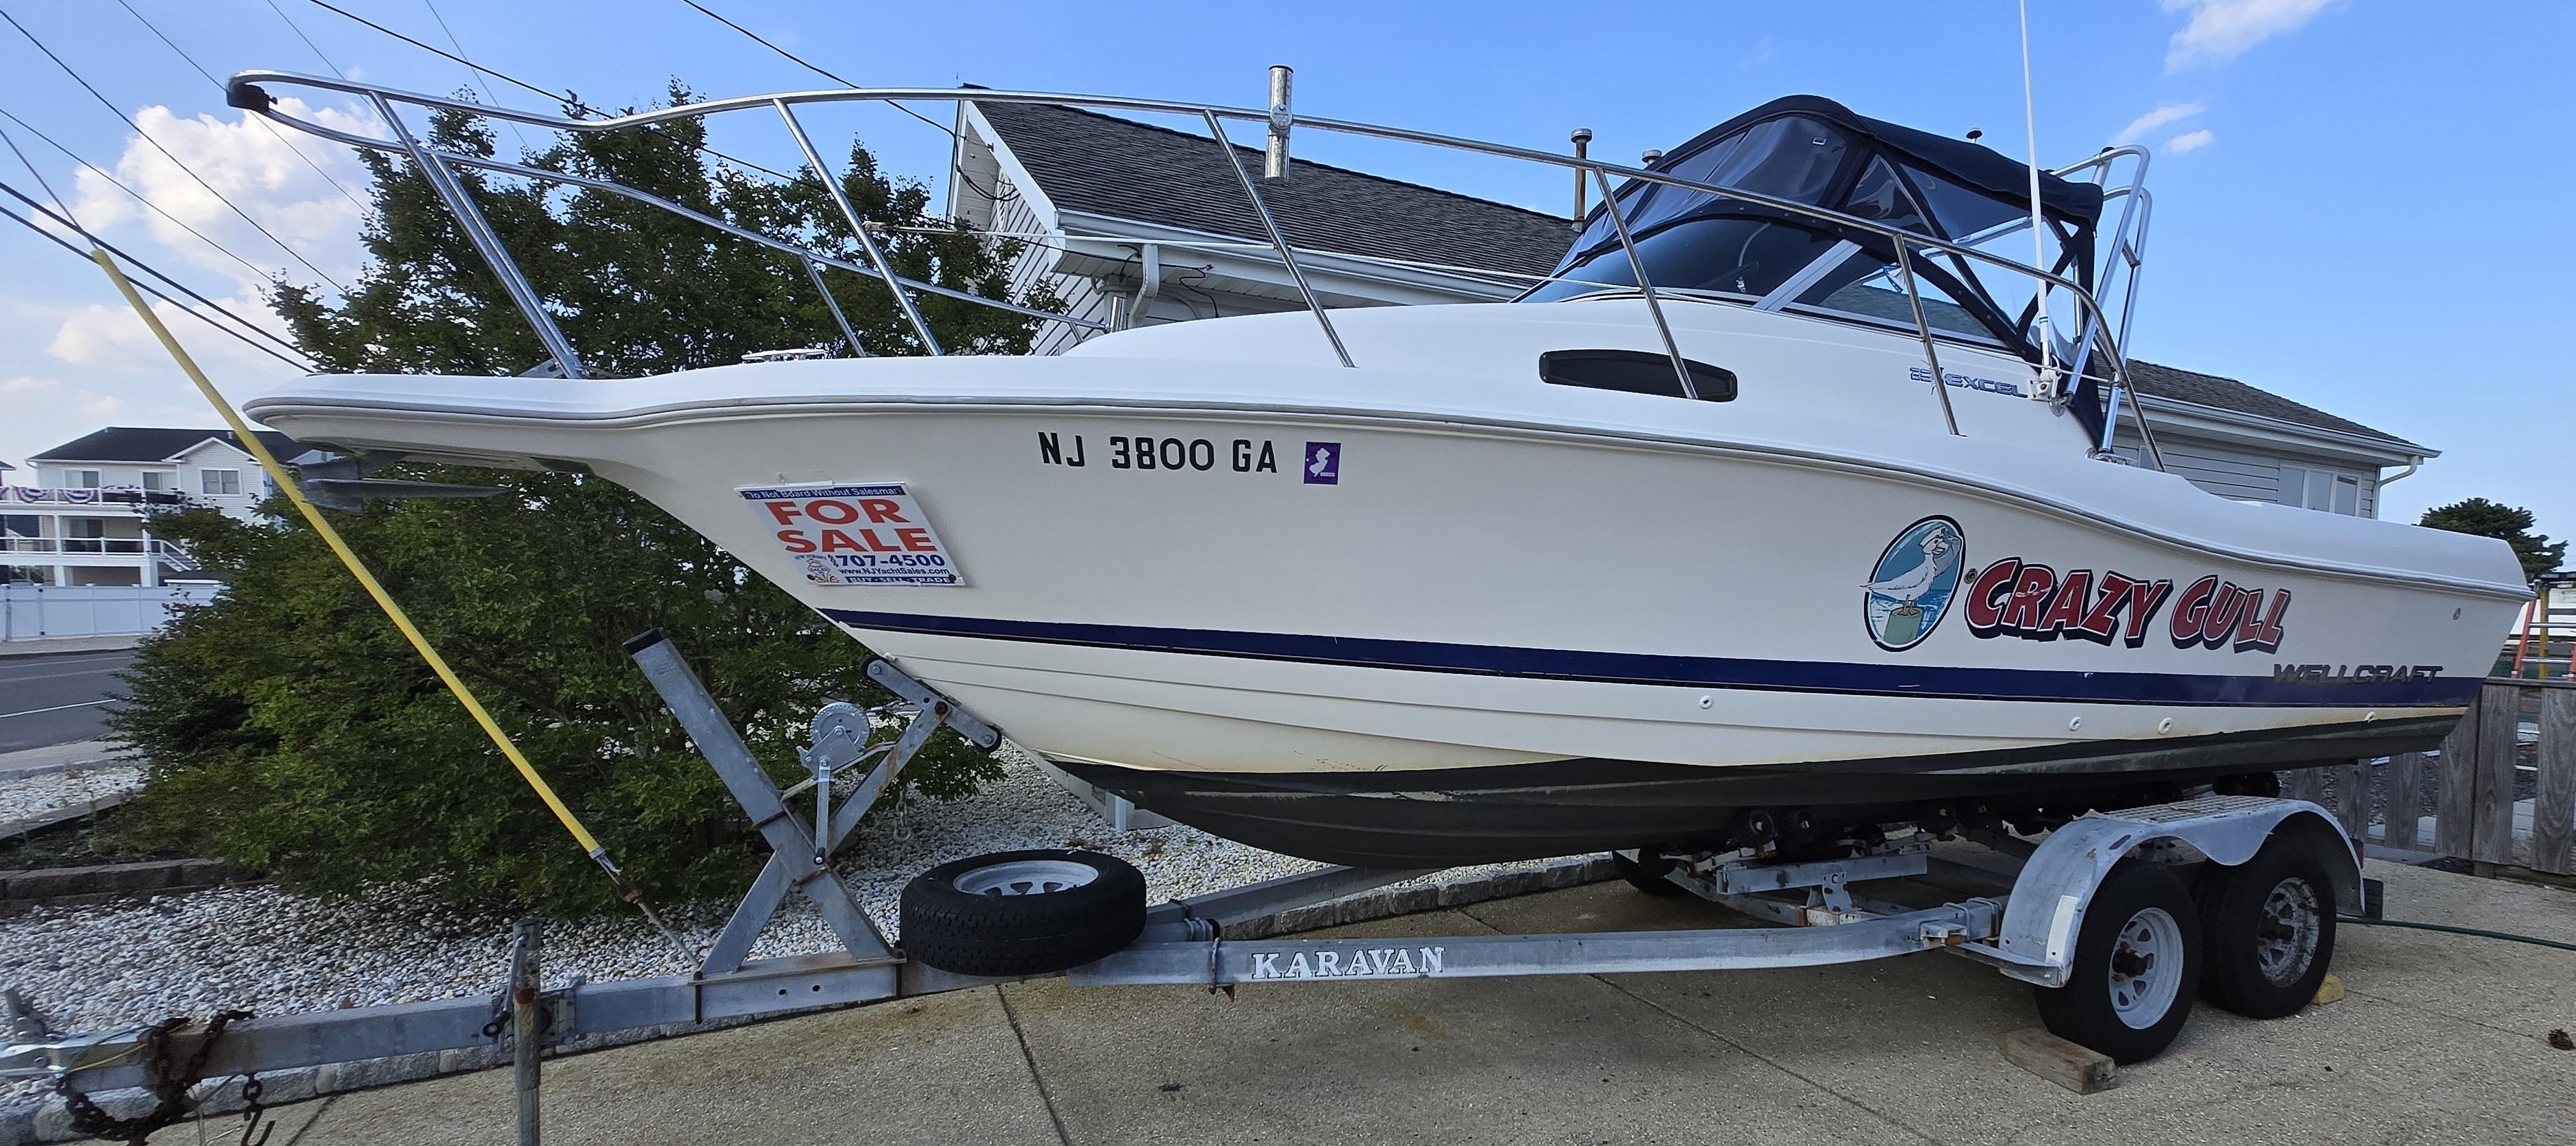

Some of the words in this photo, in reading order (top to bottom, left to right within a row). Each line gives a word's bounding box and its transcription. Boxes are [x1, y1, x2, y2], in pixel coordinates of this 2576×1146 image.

[1944, 373, 2028, 398] EXCEL
[1037, 431, 1085, 467] NJ
[1110, 436, 1215, 471] 3800
[1232, 439, 1277, 474] GA
[780, 489, 812, 498] Board
[812, 487, 852, 497] Without
[764, 498, 912, 525] FOR
[776, 527, 938, 553] SALE
[835, 554, 946, 567] 707-4500
[1964, 556, 2173, 648] CRAZY
[2169, 574, 2291, 654] GULL
[2274, 663, 2444, 685] WELLCRAFT
[1251, 946, 1446, 980] KARAVAN
